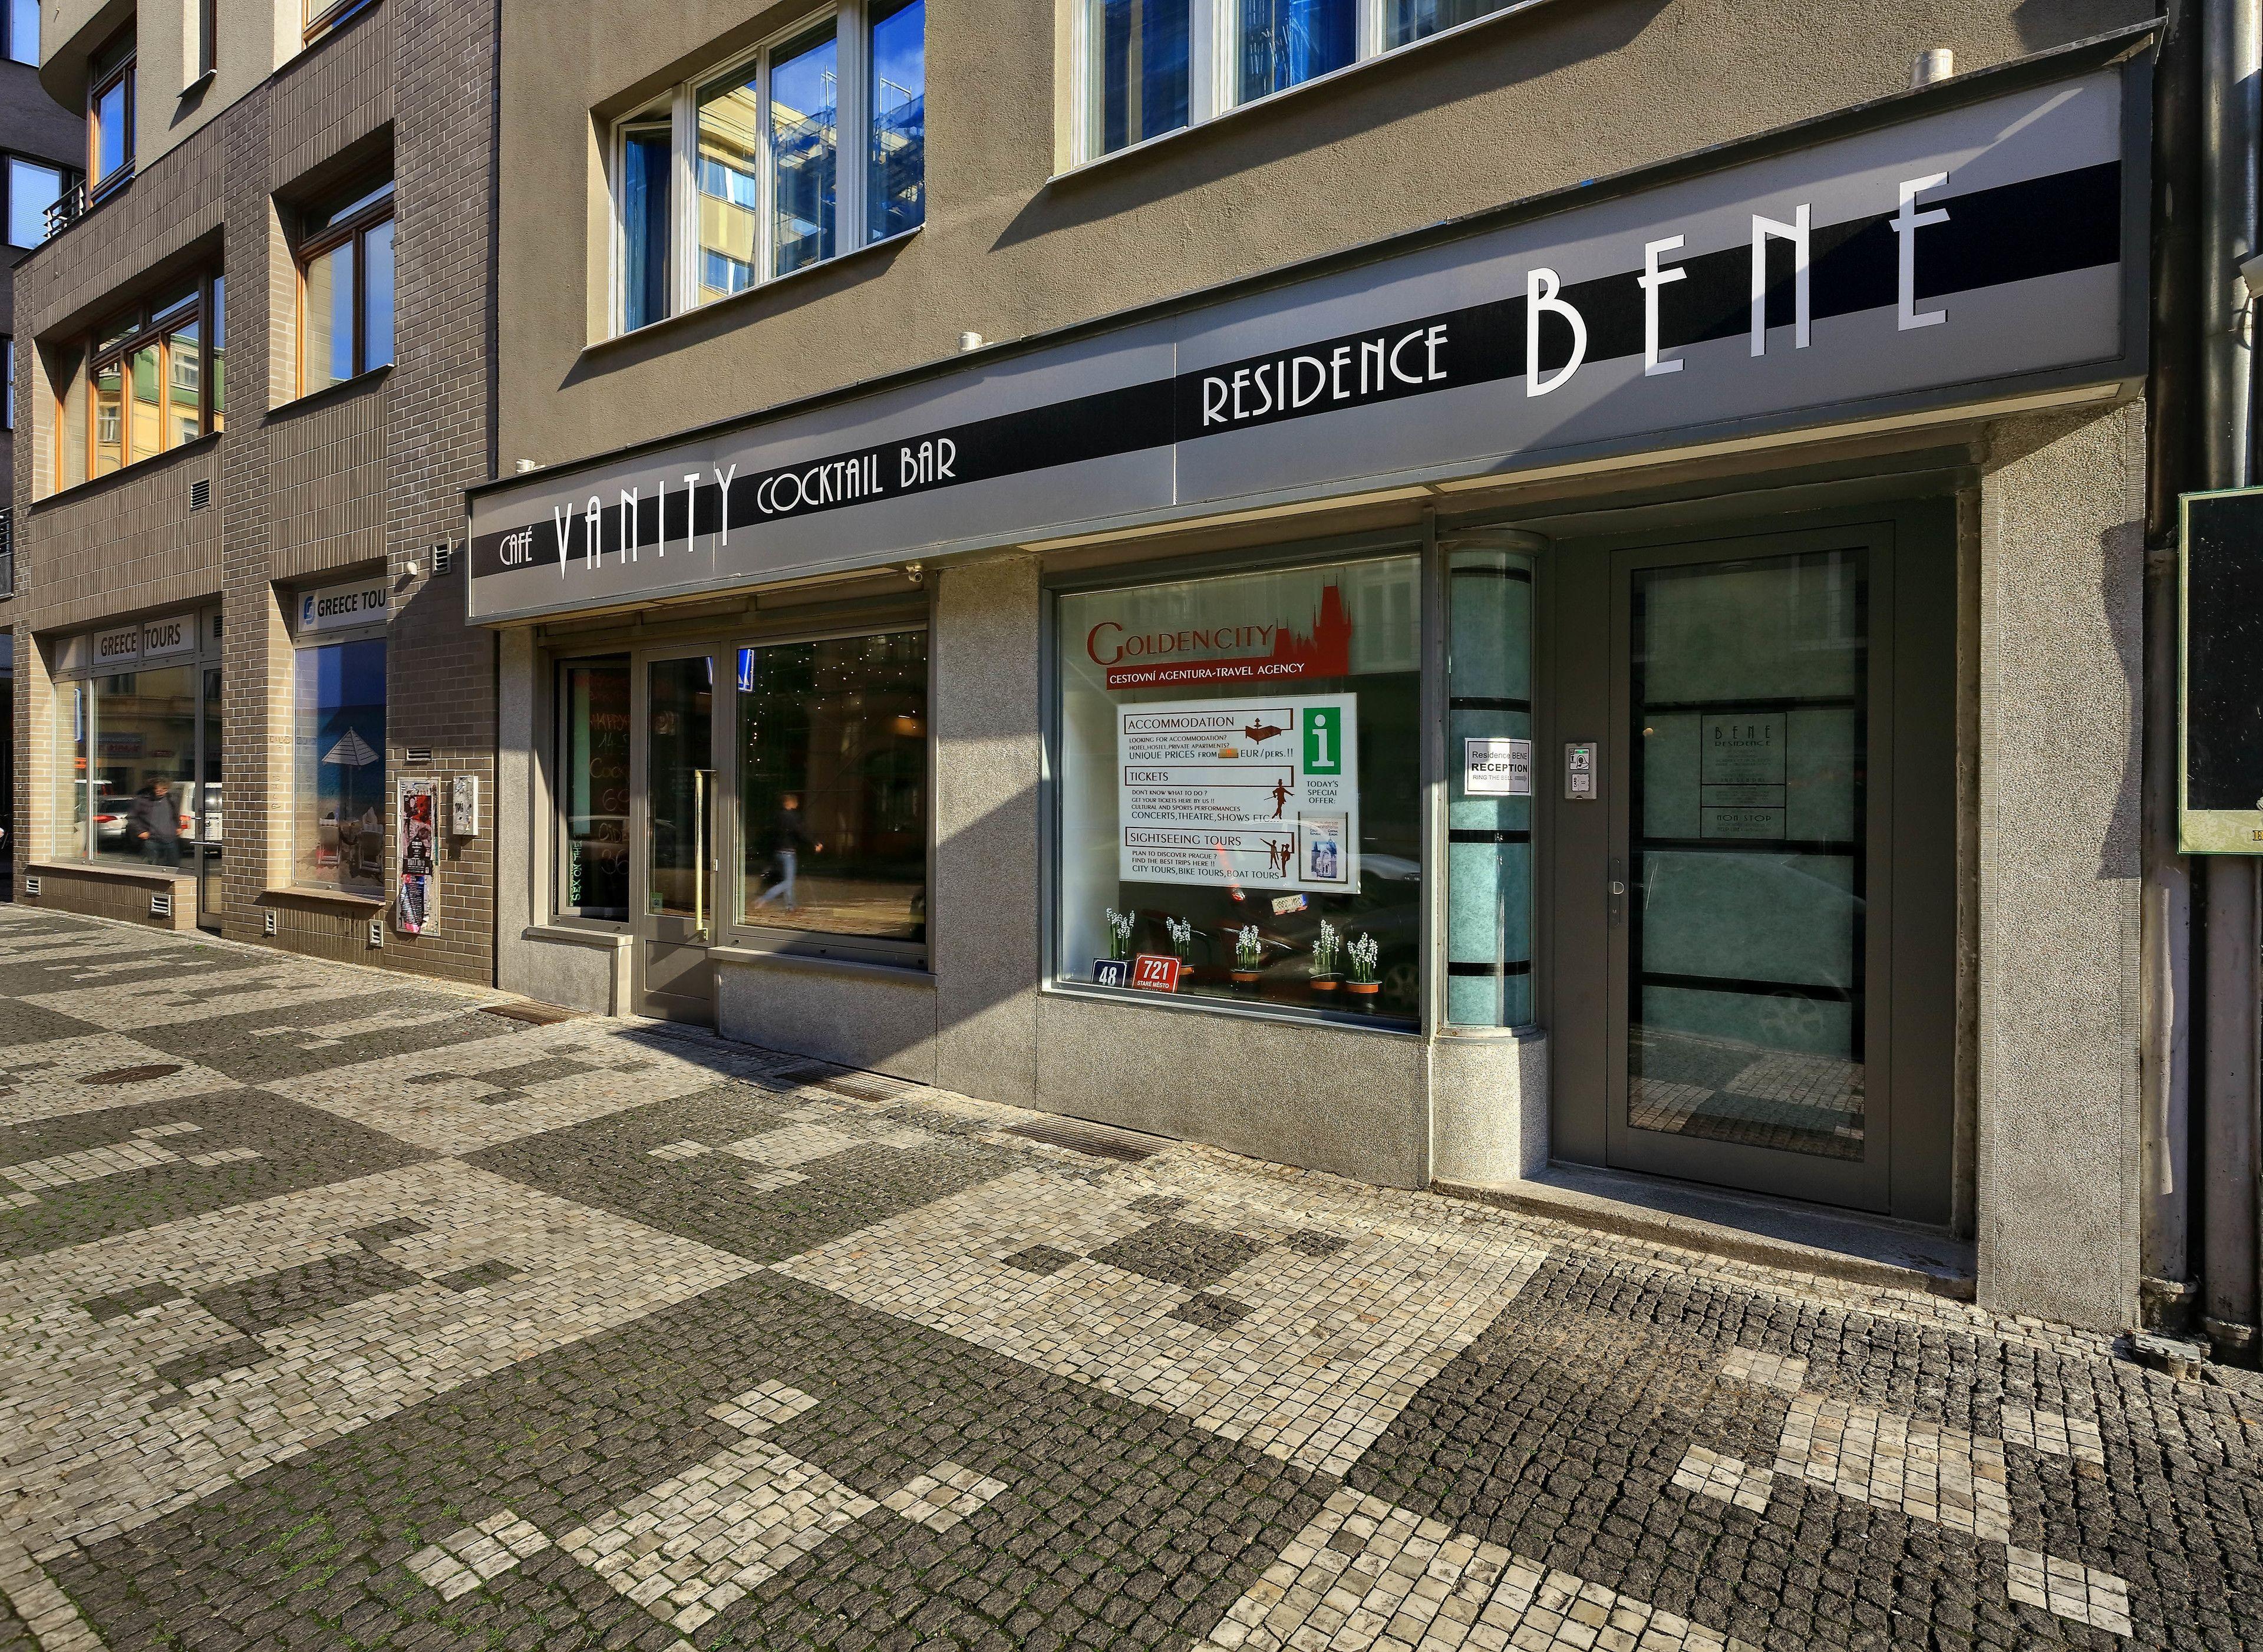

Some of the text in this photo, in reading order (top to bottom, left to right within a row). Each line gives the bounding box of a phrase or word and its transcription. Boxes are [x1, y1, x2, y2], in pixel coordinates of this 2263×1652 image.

[1527, 171, 1951, 398] BENE
[1203, 324, 1448, 426] RESIDENCE
[499, 438, 956, 580] CAFÉ VANITY COCKTAIL BAR
[318, 593, 358, 617] GREECE
[101, 623, 181, 657] GREECE TOURS
[1110, 663, 1305, 684] CESTOVNÍ AGENTURA-TRAVEL AGENCY
[1128, 717, 1235, 730] ACCOMMODATION
[1716, 725, 1770, 739] BENE
[1129, 751, 1162, 760] UNIQUE
[1472, 751, 1510, 759] Residence
[1472, 763, 1528, 773] RECEPTION
[1130, 772, 1169, 782] TICKETS
[1130, 832, 1241, 846] SIGHTSEEING TOURS
[573, 864, 582, 876] ON
[1252, 871, 1279, 879] TOURS
[572, 879, 581, 901] SEX
[1098, 966, 1117, 987] 48
[1143, 960, 1169, 980] 721
